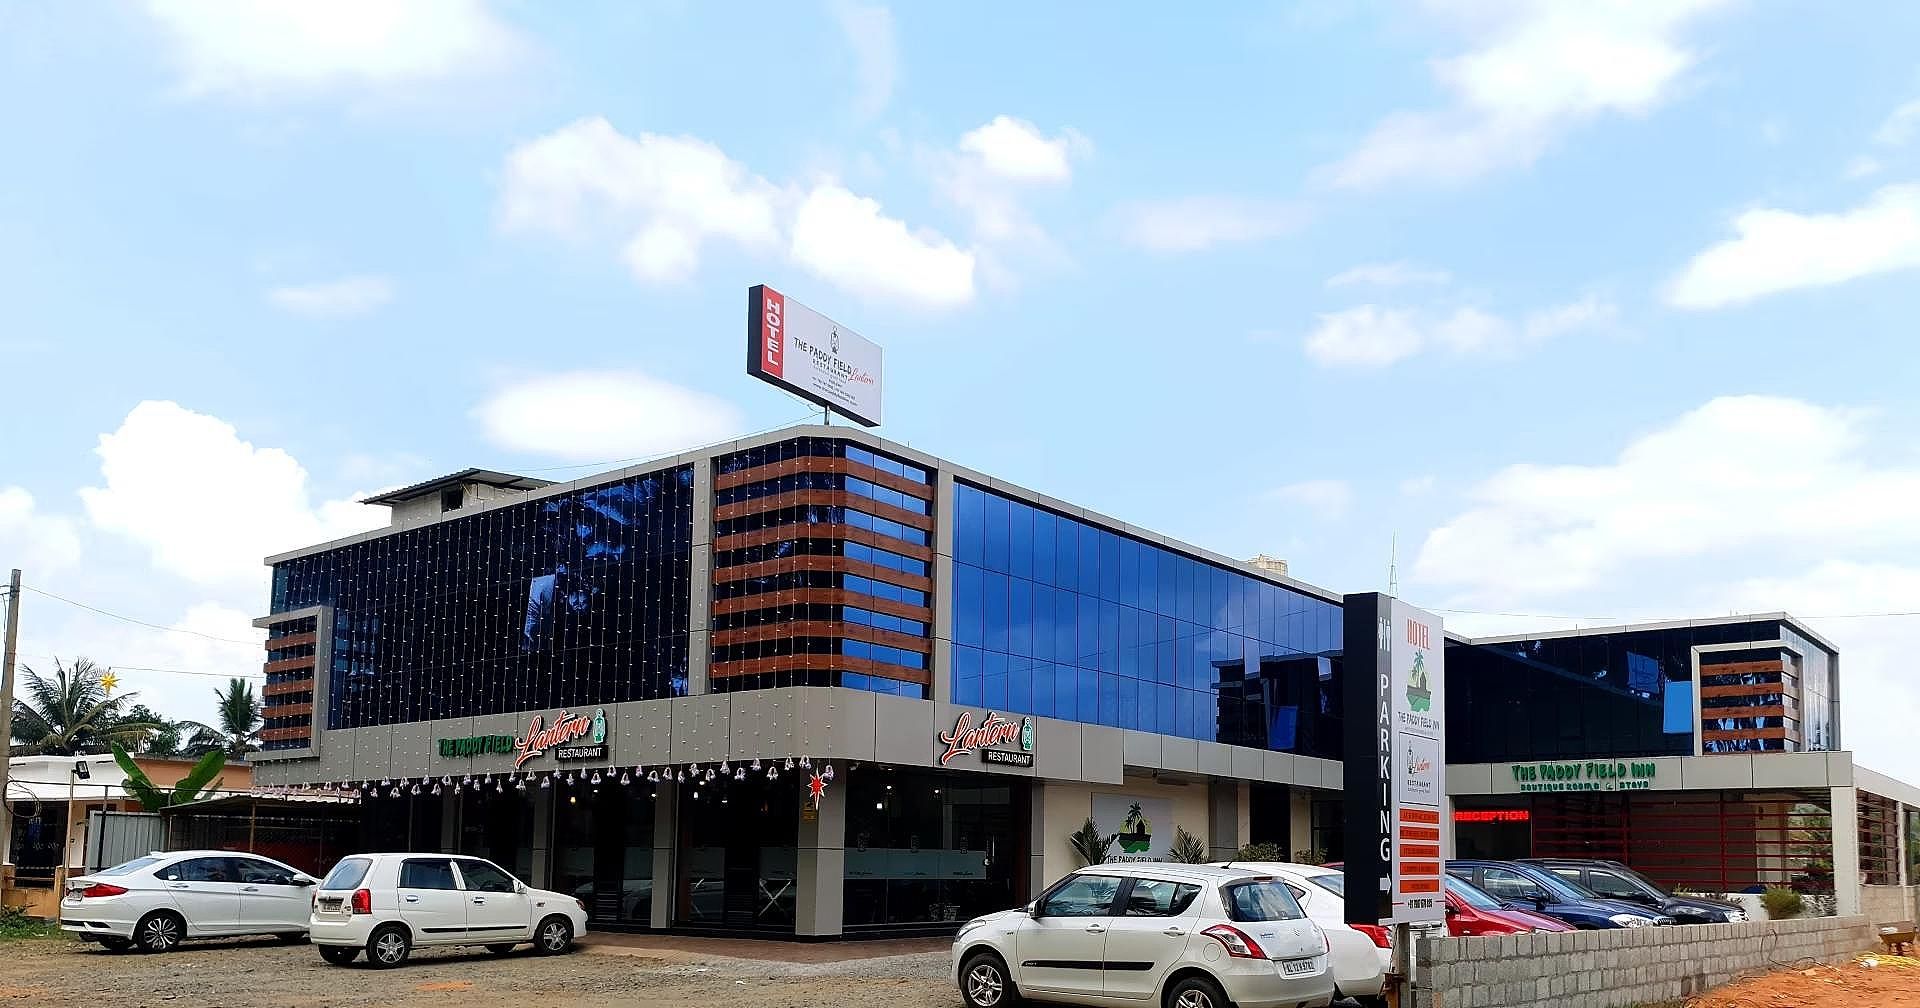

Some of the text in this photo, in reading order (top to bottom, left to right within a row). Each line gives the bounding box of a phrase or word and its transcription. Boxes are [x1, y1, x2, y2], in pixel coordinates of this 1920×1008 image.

[766, 299, 780, 366] HOTEL
[794, 337, 807, 352] THE
[809, 345, 832, 363] PADDY
[833, 358, 851, 375] FIELD
[1407, 617, 1430, 650] HOTEL
[438, 738, 454, 757] THE
[485, 734, 513, 753] FIELD
[515, 709, 590, 769] Lantern
[558, 747, 602, 759] RESTAURANT
[940, 711, 1020, 766] Lantern
[988, 751, 1031, 765] RESTAURANT
[1379, 673, 1391, 862] PARKING
[1511, 762, 1656, 782] THE PADDY FIELD INN
[1520, 783, 1564, 791] BOUTIQUE
[1619, 780, 1649, 789] STAYS
[1454, 810, 1529, 822] RECEPTION
